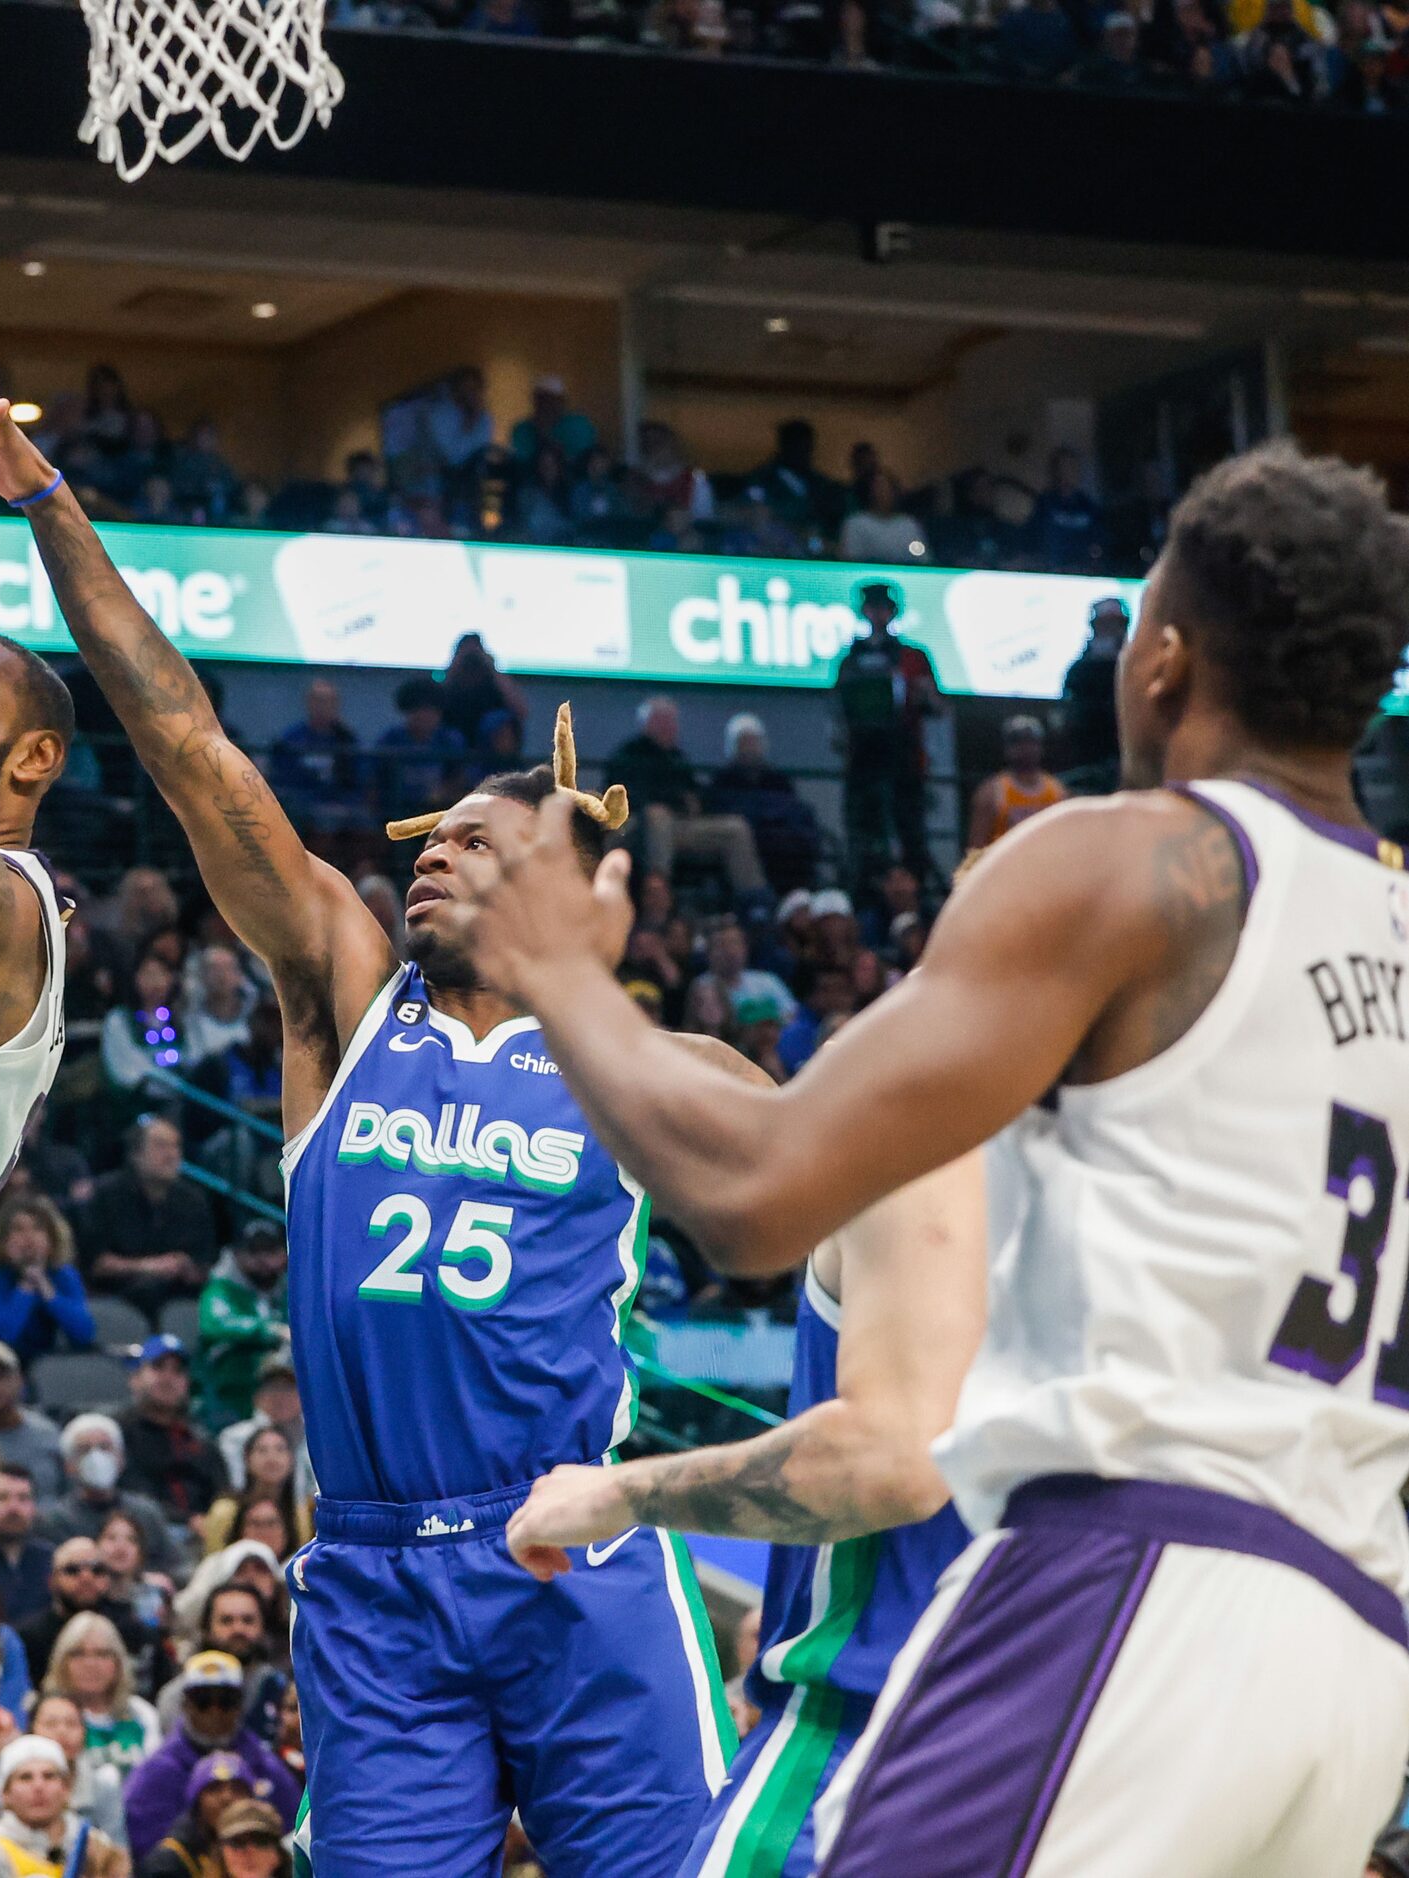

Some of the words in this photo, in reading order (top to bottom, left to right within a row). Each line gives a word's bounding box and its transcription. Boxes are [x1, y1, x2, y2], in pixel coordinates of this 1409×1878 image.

[669, 574, 872, 667] chim
[396, 1002, 422, 1024] 6
[510, 1052, 563, 1076] chim
[337, 1101, 585, 1195] Dallas
[358, 1192, 515, 1312] 25
